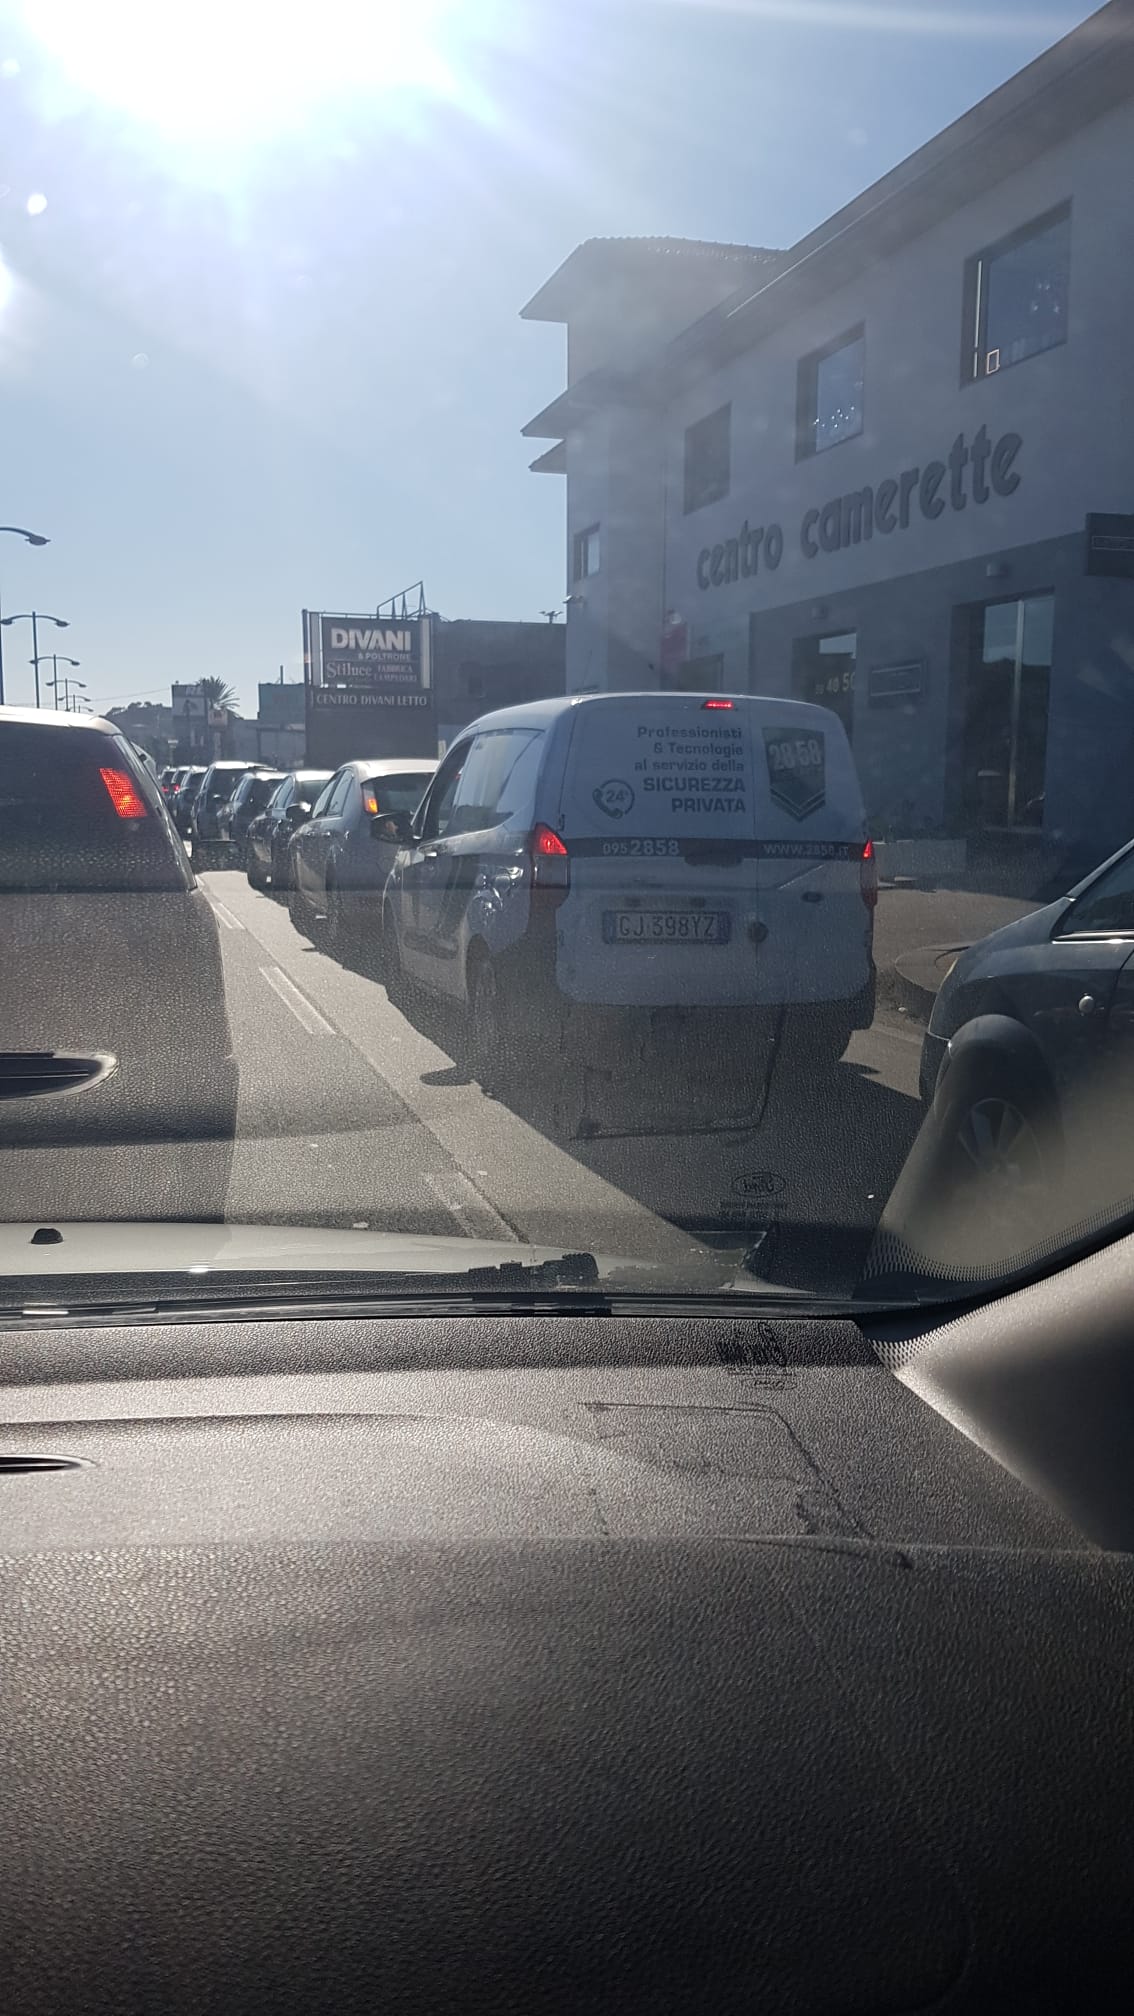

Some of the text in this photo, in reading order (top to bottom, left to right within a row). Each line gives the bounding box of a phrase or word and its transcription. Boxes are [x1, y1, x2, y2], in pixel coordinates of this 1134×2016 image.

[696, 424, 1023, 590] centro camerette
[331, 628, 412, 651] DIVANI
[326, 662, 373, 678] Stiluce
[316, 694, 428, 706] CENTRO DIVANI LETTO
[636, 725, 743, 739] Professionisti
[653, 742, 744, 758] & Tecnologie
[634, 758, 745, 772] al servizio della
[643, 777, 746, 792] SICUREZZA
[671, 798, 746, 813] PRIVATA
[630, 840, 680, 856] 2858
